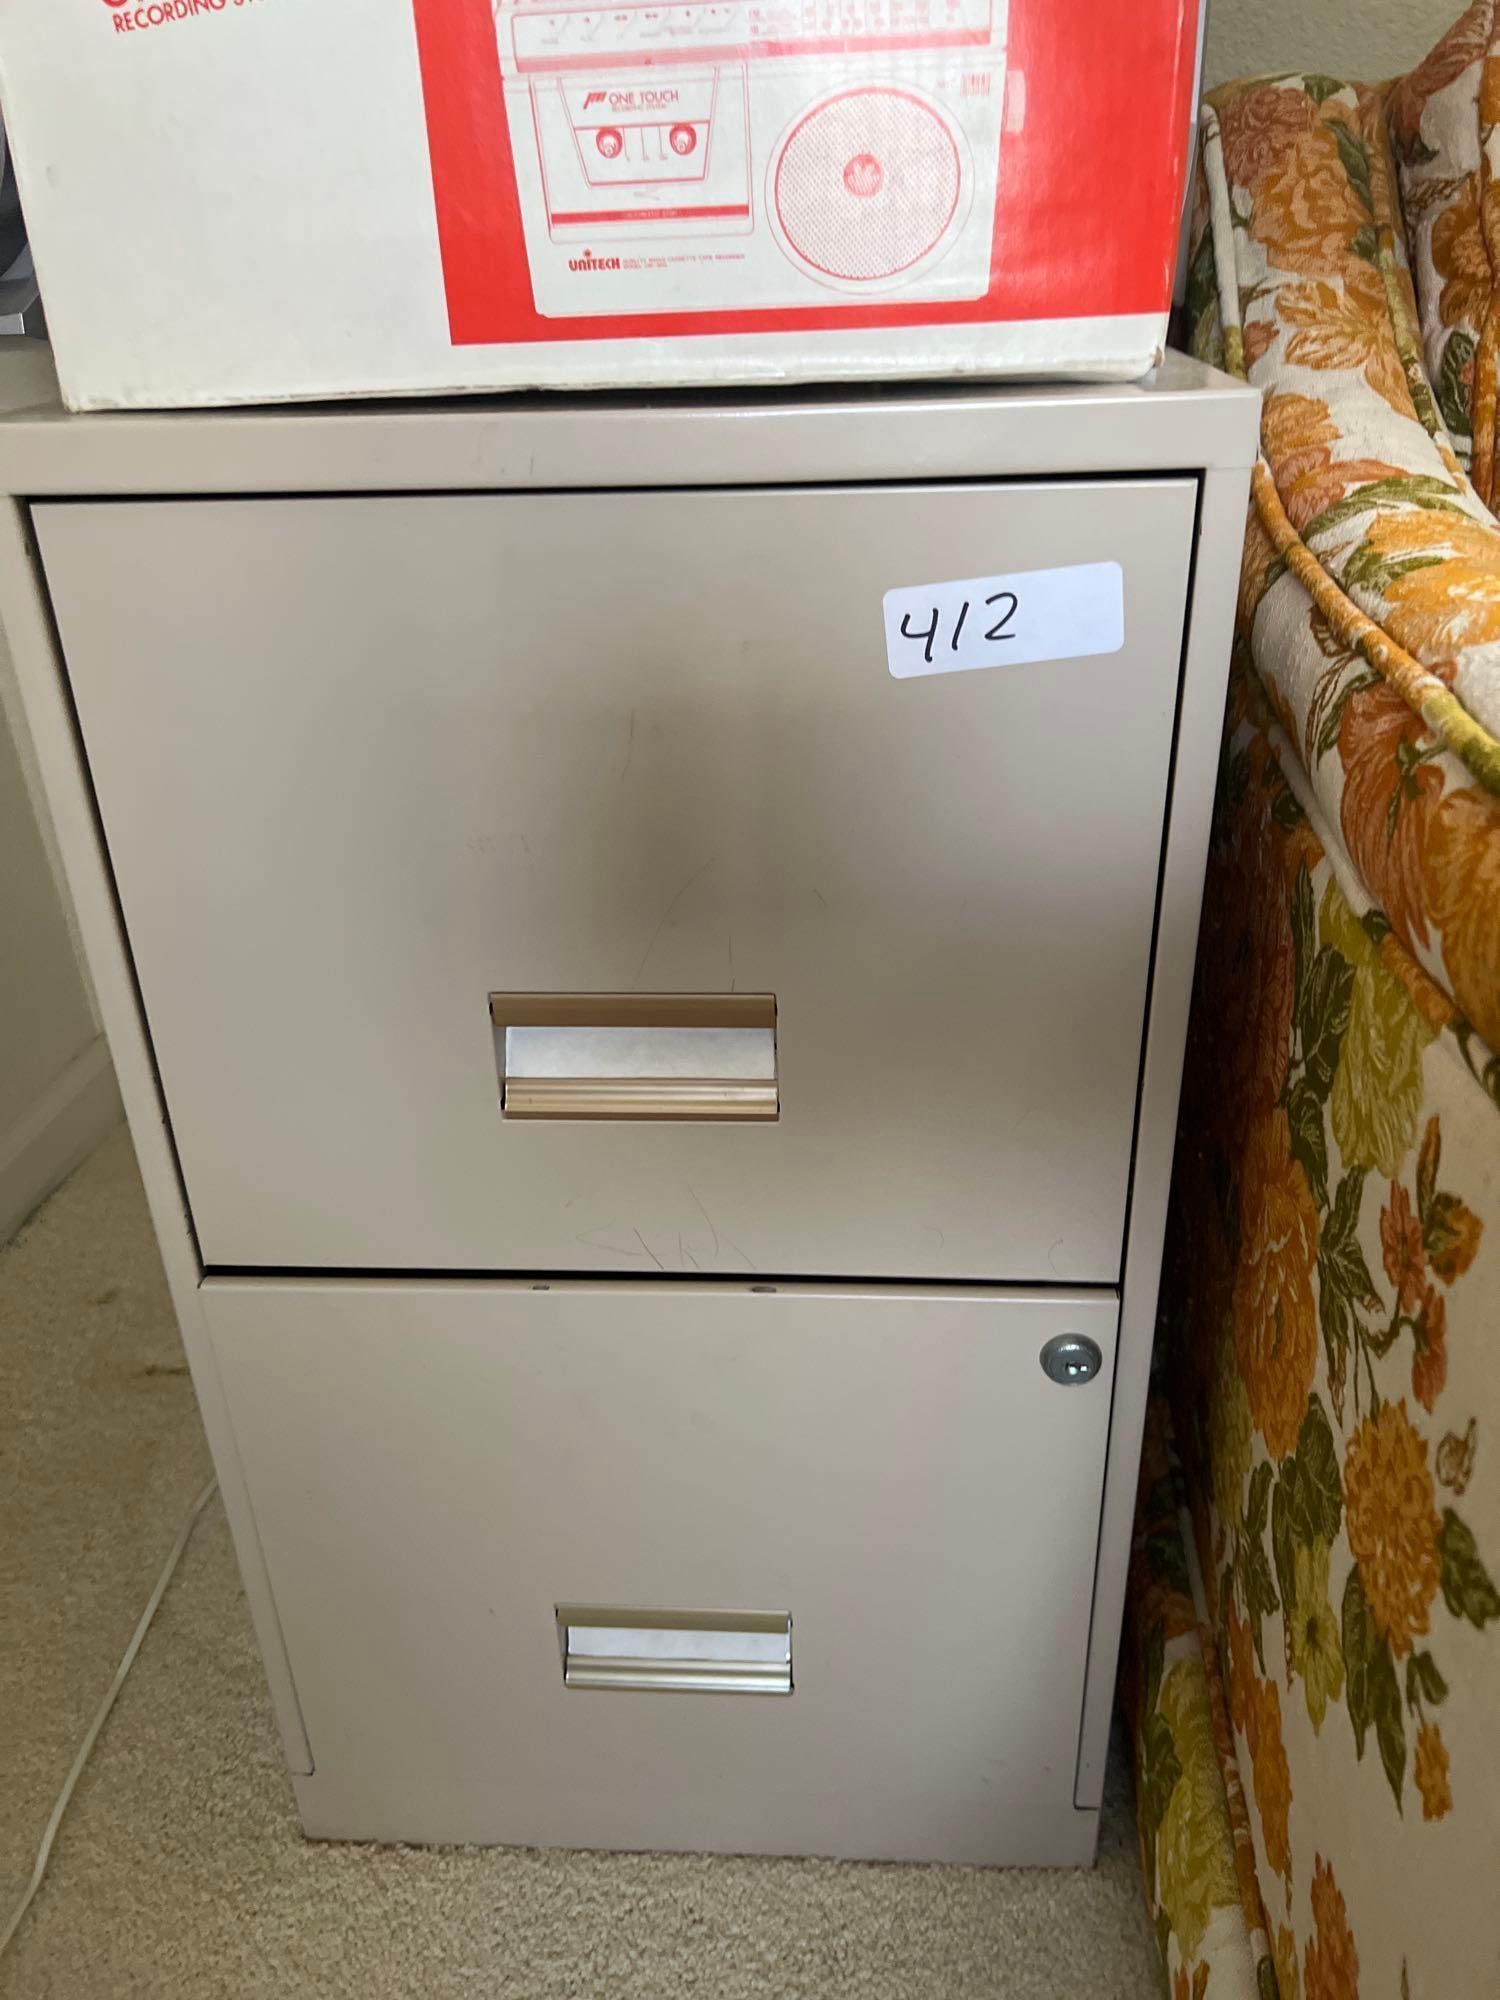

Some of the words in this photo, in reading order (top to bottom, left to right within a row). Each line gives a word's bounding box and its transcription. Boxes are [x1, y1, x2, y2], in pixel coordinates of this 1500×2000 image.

[608, 91, 634, 105] ONE
[640, 88, 679, 104] TOUCH
[900, 592, 1018, 662] 412
